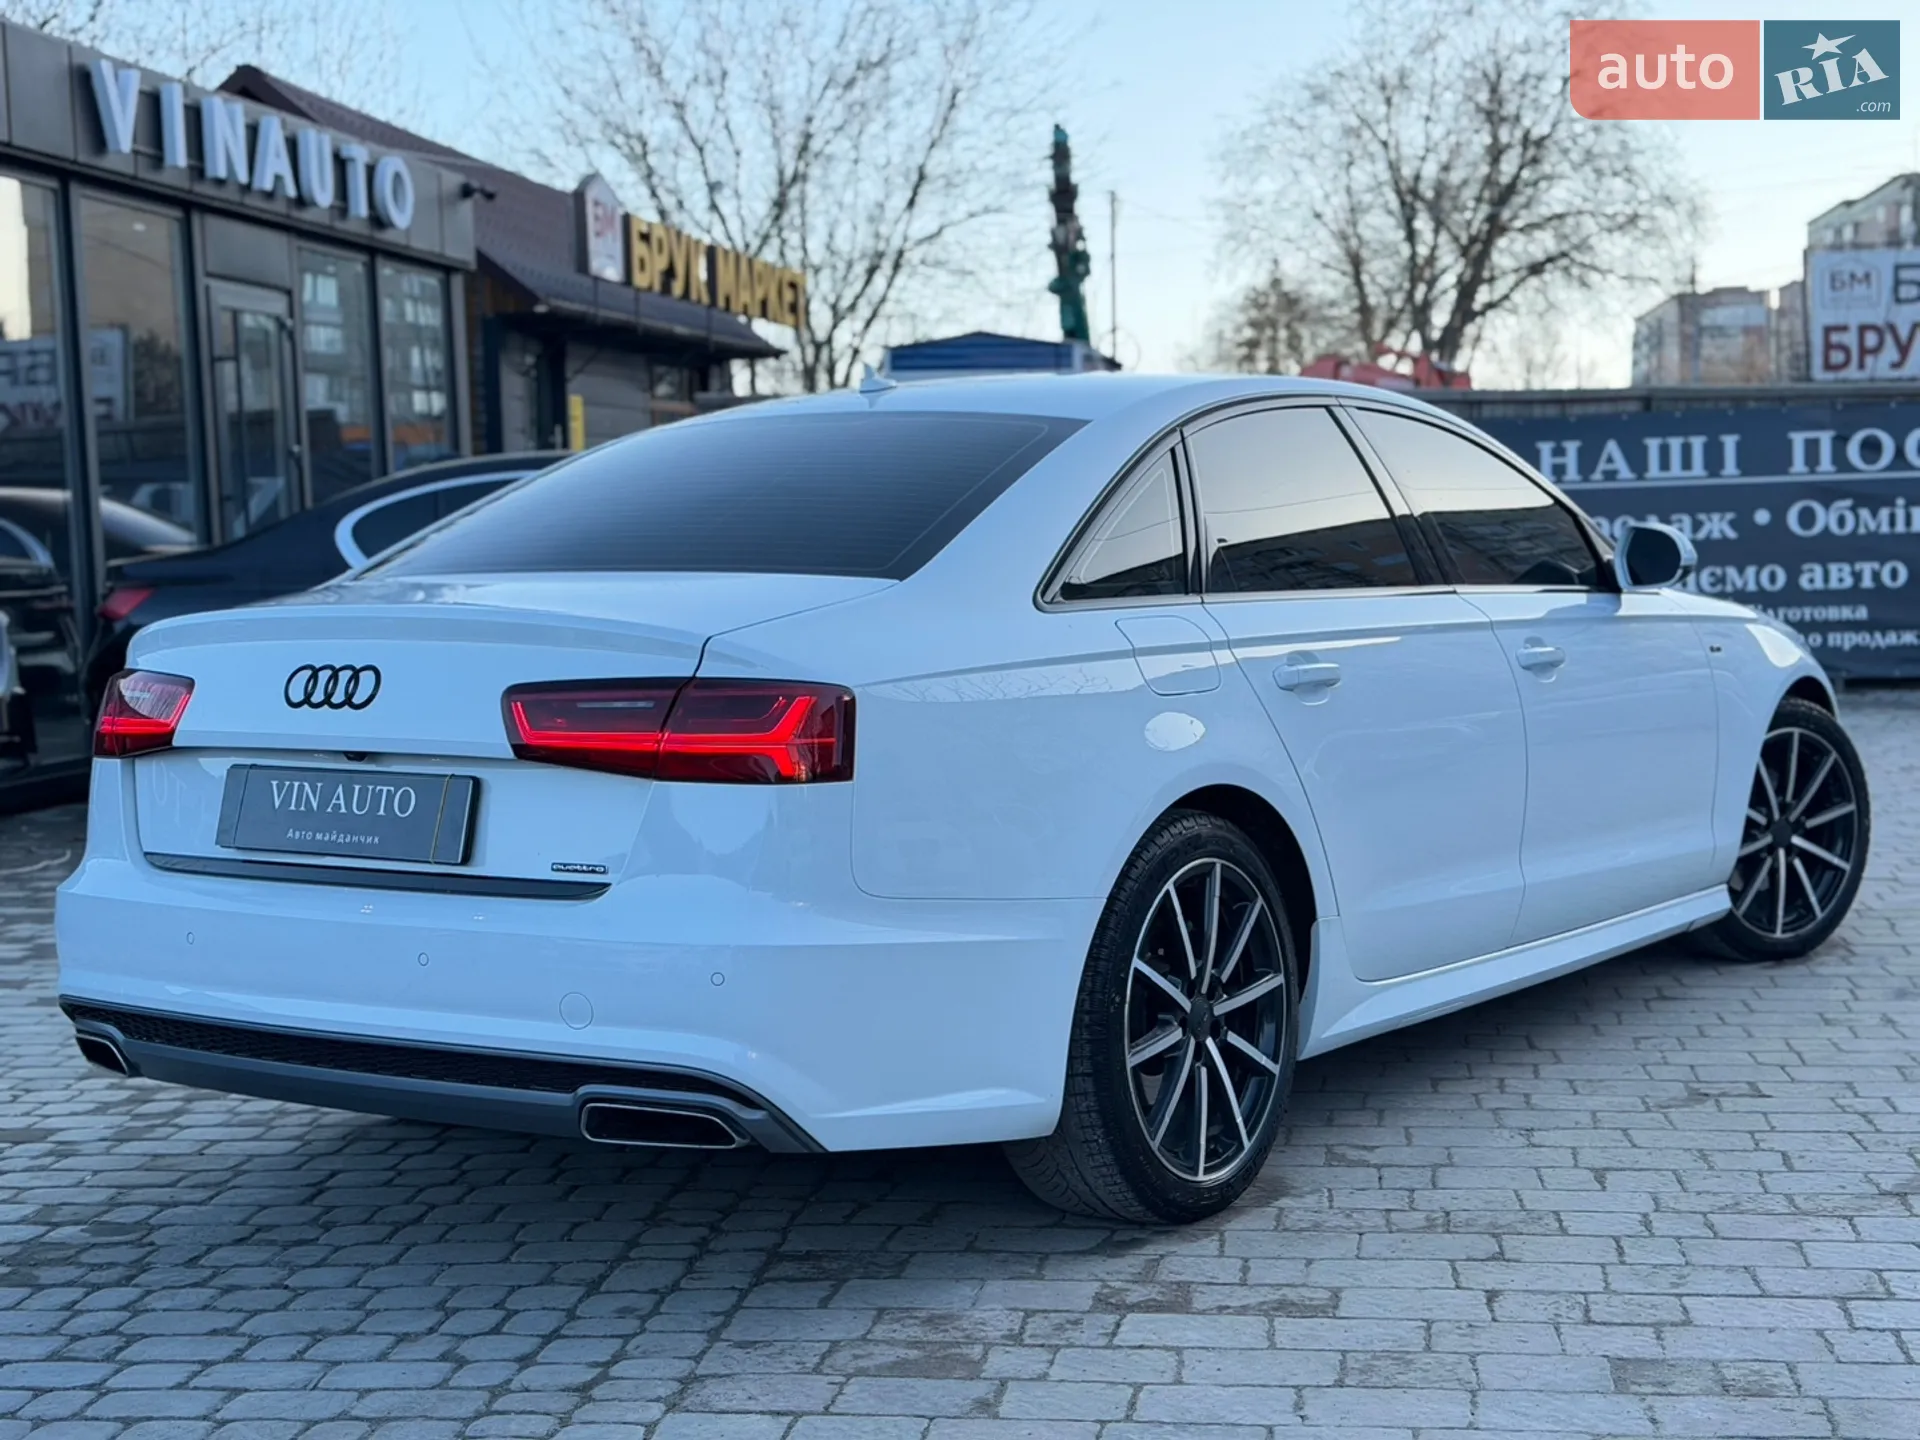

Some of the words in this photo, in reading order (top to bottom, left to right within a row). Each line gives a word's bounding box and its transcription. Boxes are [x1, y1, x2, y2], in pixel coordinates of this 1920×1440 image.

[90, 58, 415, 230] VINAUTO
[628, 212, 710, 306] БРУК
[1829, 270, 1871, 292] БМ
[1823, 321, 1920, 373] БРУ
[1535, 434, 1741, 482] НАШІ
[1798, 560, 1909, 590] авто
[270, 780, 323, 812] VIN
[326, 783, 416, 818] AUTO
[286, 827, 313, 841] Авто
[314, 830, 380, 845] майданчик
